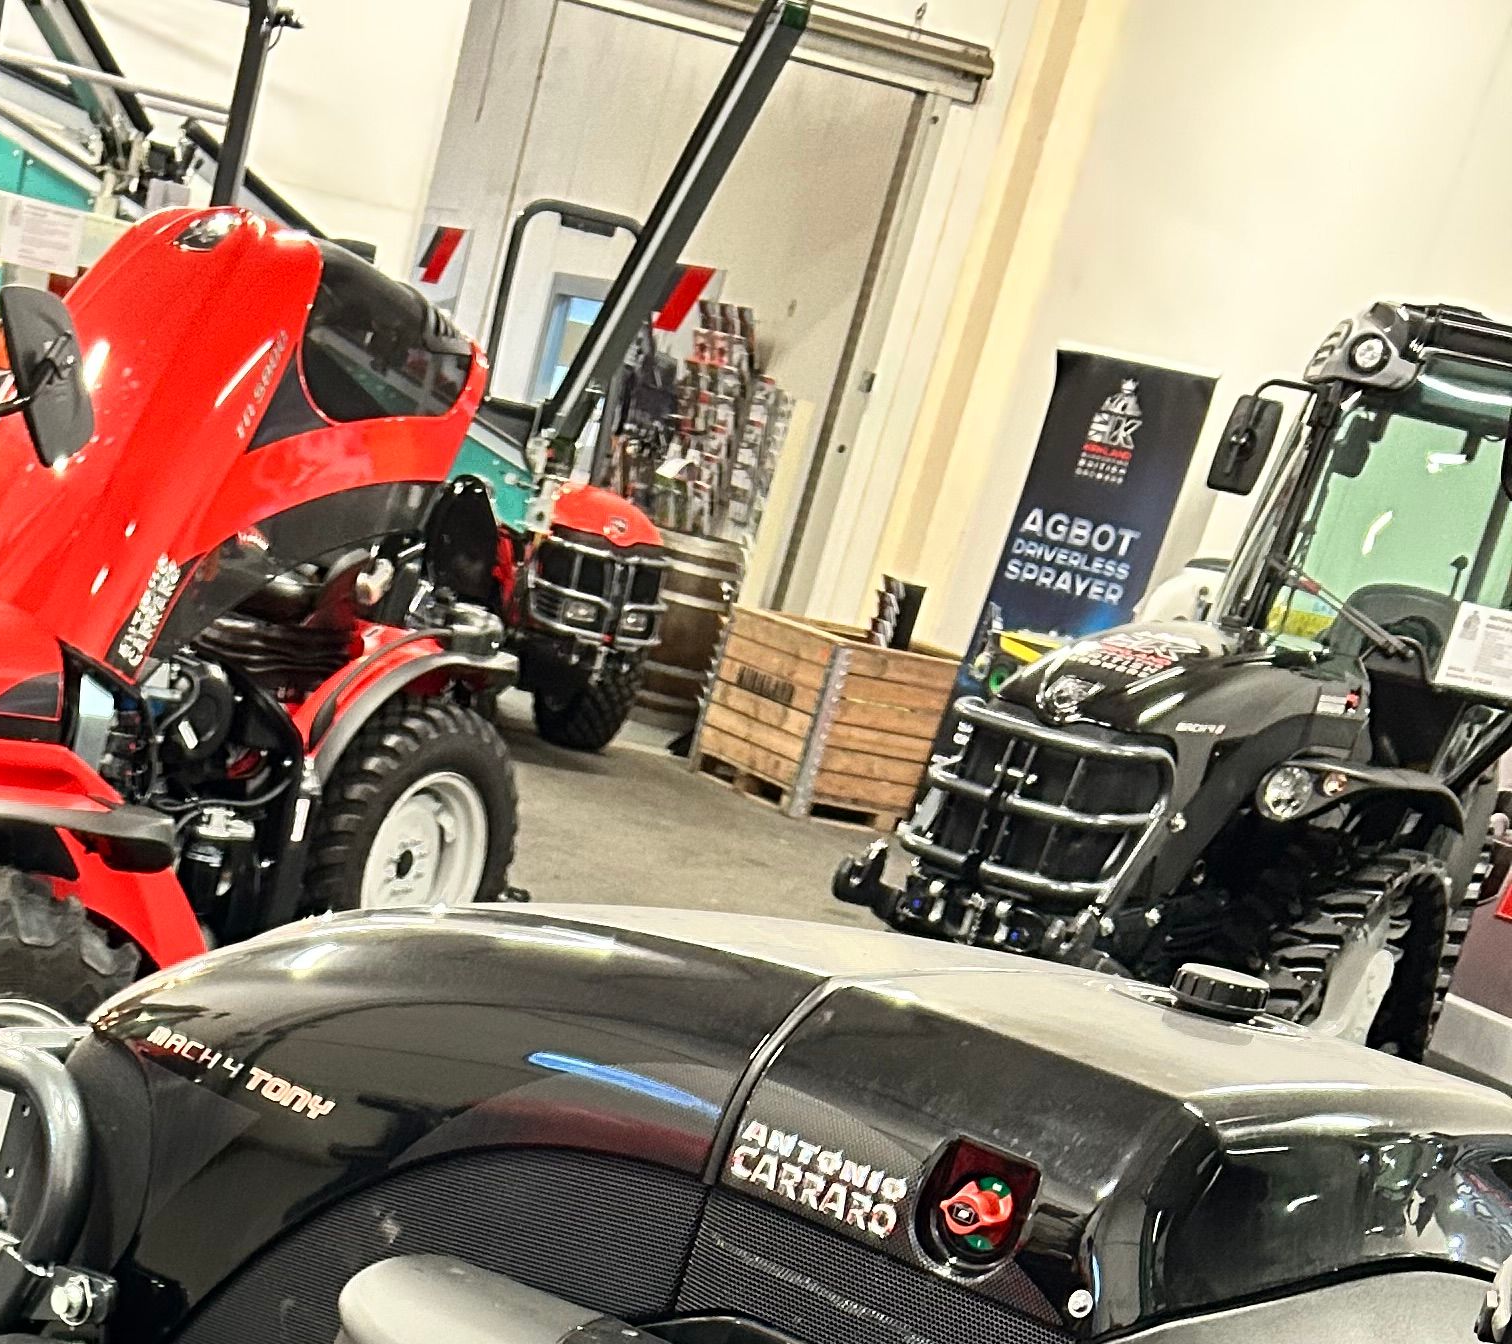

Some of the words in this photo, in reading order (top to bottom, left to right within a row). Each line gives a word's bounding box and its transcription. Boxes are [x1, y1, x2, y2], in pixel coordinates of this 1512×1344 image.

[1011, 538, 1131, 580] DRIVERLESS
[1018, 506, 1141, 556] AGBOT
[1004, 558, 1124, 605] SPRAYER
[146, 1025, 222, 1070] MACH
[222, 1057, 245, 1079] 4
[245, 1066, 337, 1120] TONY
[730, 1145, 897, 1239] CARRARO
[741, 1120, 907, 1203] ANTONIO
